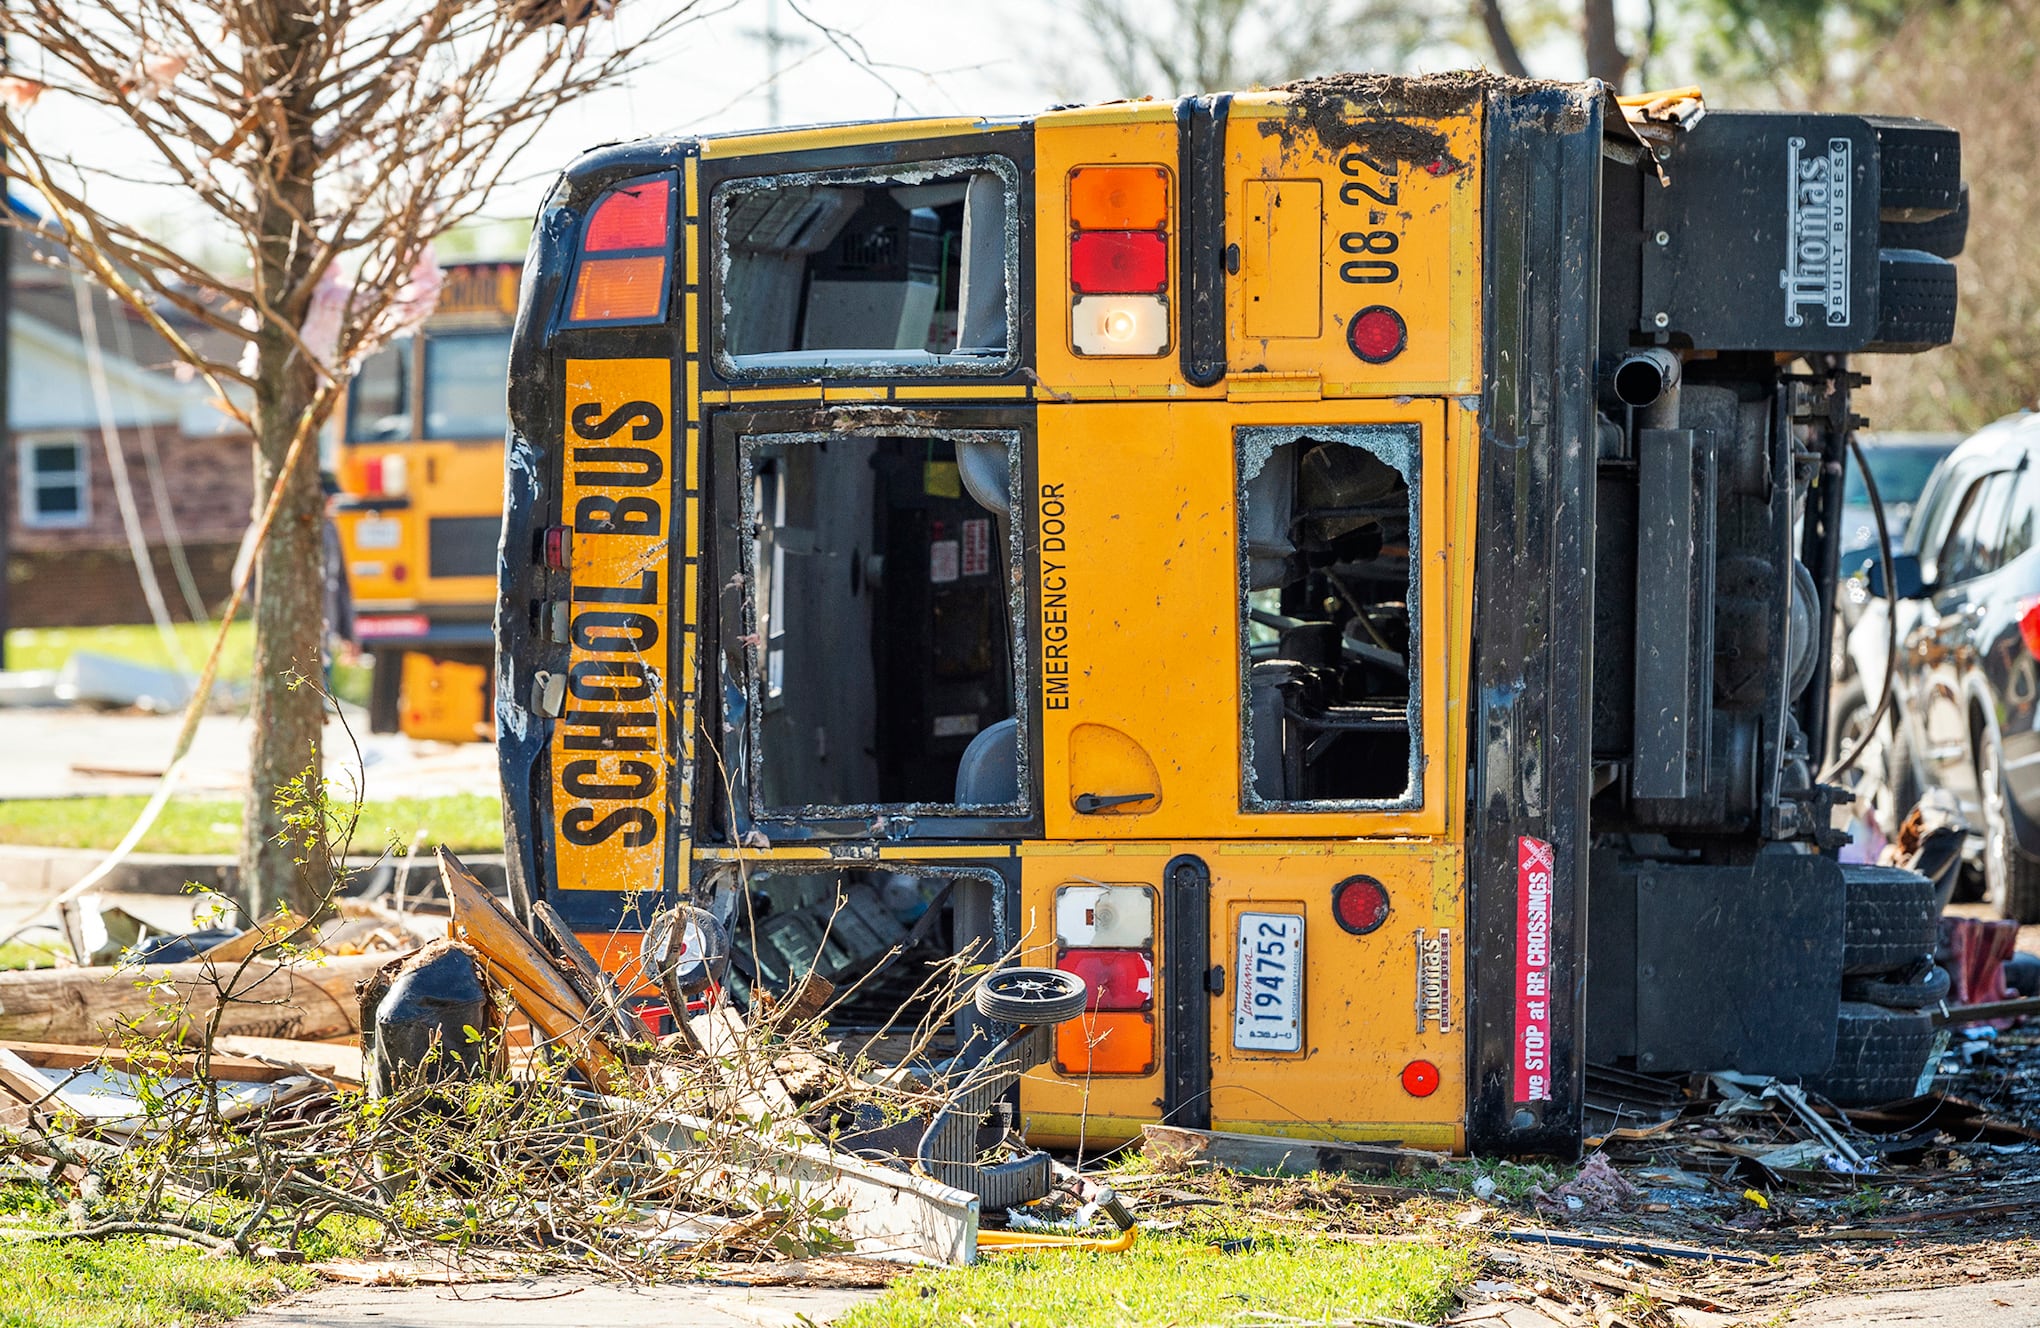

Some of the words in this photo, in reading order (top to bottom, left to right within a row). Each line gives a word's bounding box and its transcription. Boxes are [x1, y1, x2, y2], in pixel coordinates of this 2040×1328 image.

[1339, 153, 1399, 284] 08-22
[1833, 158, 1844, 232] BUSES
[1779, 137, 1829, 327] Thomas
[1832, 245, 1843, 306] BUILT
[571, 400, 663, 536] BUS
[1041, 483, 1067, 552] DOOR
[1043, 560, 1069, 710] EMERGENCY
[561, 571, 660, 847] SCHOOL
[1527, 872, 1547, 967] CROSSINGS
[1240, 947, 1253, 1016] Louisiana
[1254, 923, 1286, 1021] 194752
[1414, 928, 1440, 1033] Thomas
[1441, 936, 1449, 980] BUSES
[1527, 971, 1545, 996] RR
[1249, 1030, 1292, 1039] PUBLIC
[1528, 1001, 1545, 1020] at
[1525, 1025, 1544, 1070] STOP
[1528, 1075, 1543, 1100] we
